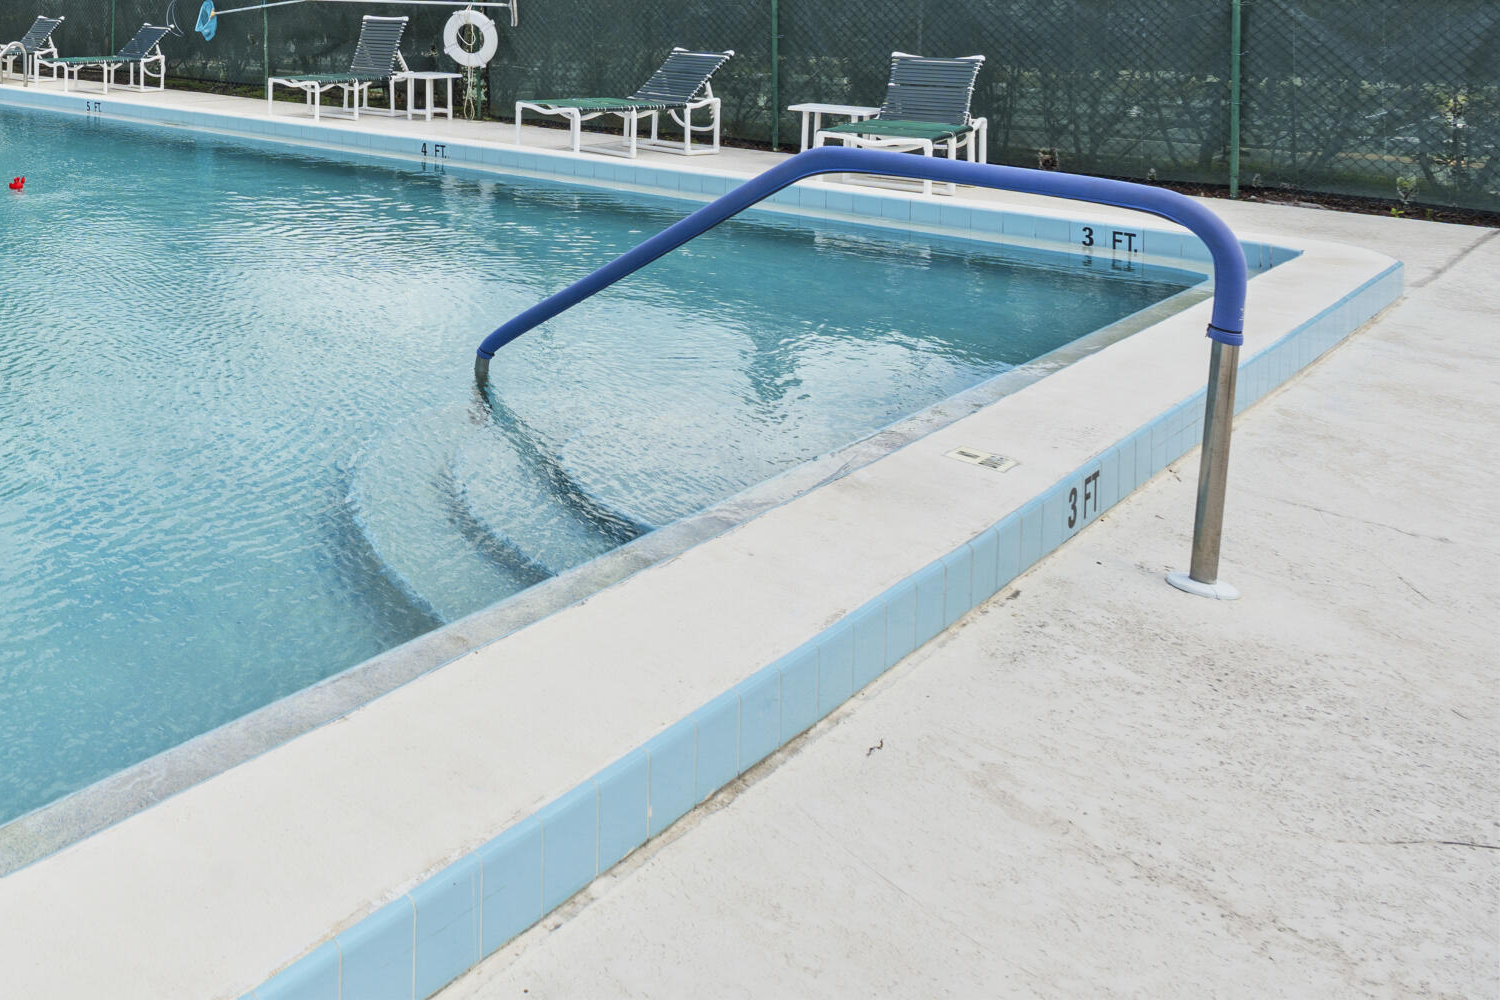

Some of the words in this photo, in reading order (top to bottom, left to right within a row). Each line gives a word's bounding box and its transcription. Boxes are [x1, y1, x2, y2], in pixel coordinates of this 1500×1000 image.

[86, 101, 90, 111] 5
[421, 142, 427, 156] 4
[435, 144, 447, 159] FT.
[1082, 226, 1094, 247] 3
[1112, 231, 1138, 253] FT.
[1068, 487, 1077, 529] 3
[1083, 469, 1100, 520] FT
